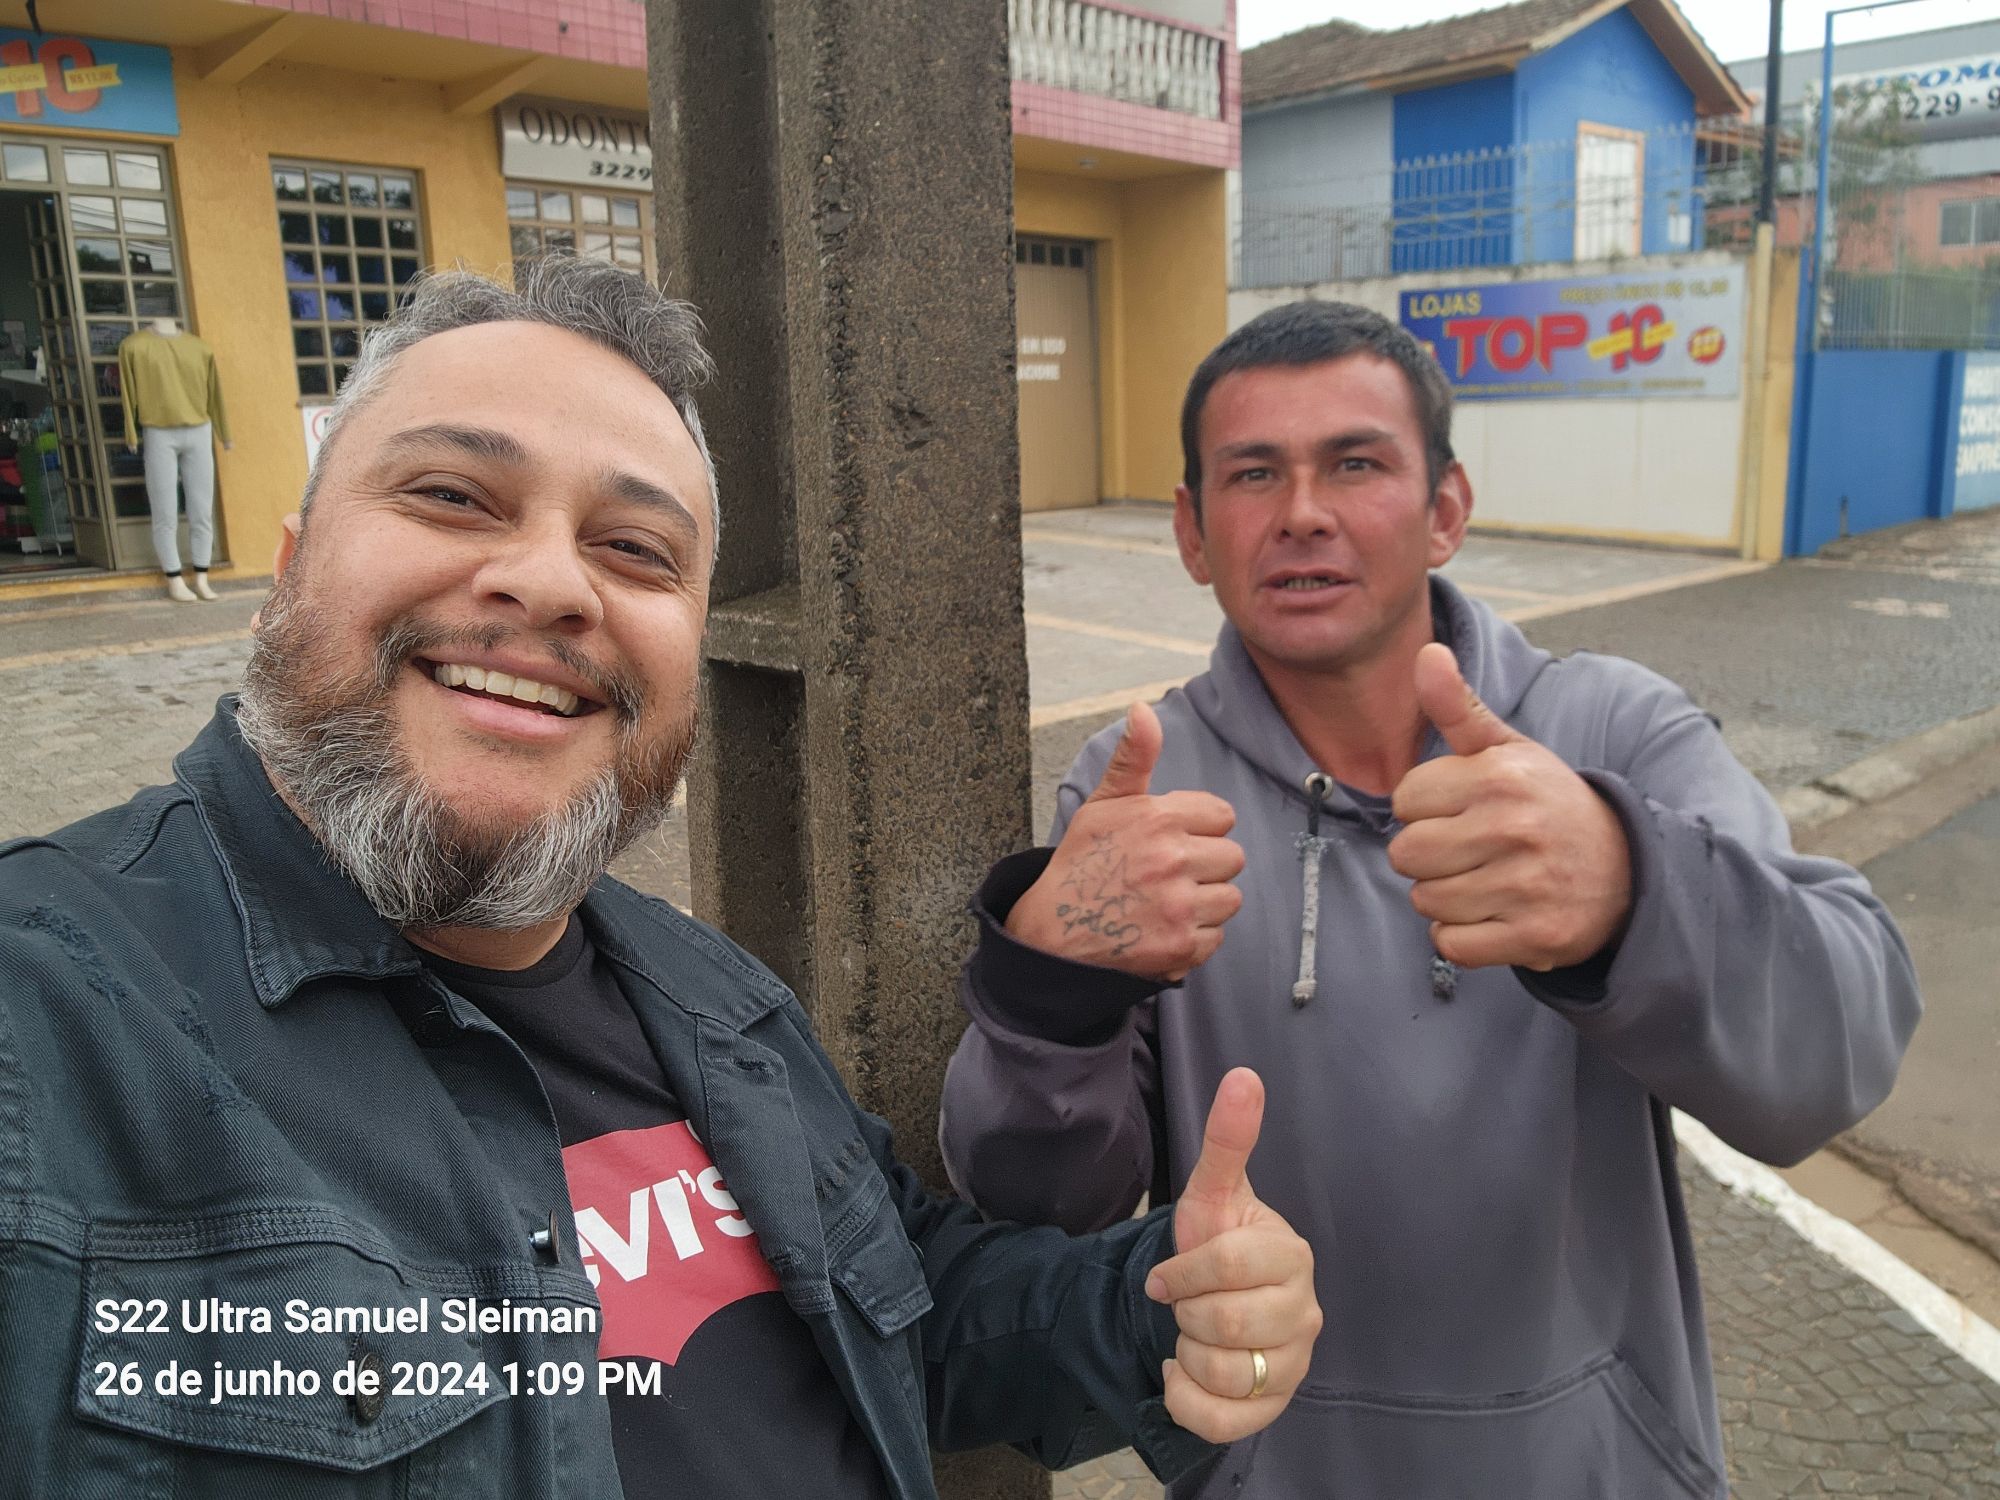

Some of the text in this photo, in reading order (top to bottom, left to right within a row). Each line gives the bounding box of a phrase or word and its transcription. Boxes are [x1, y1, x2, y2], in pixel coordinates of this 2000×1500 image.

[0, 38, 100, 118] 10
[519, 106, 651, 153] ODONT
[590, 160, 652, 181] 3229
[1410, 292, 1482, 318] LOJAS
[1444, 313, 1588, 378] TOP
[1609, 304, 1665, 373] 10
